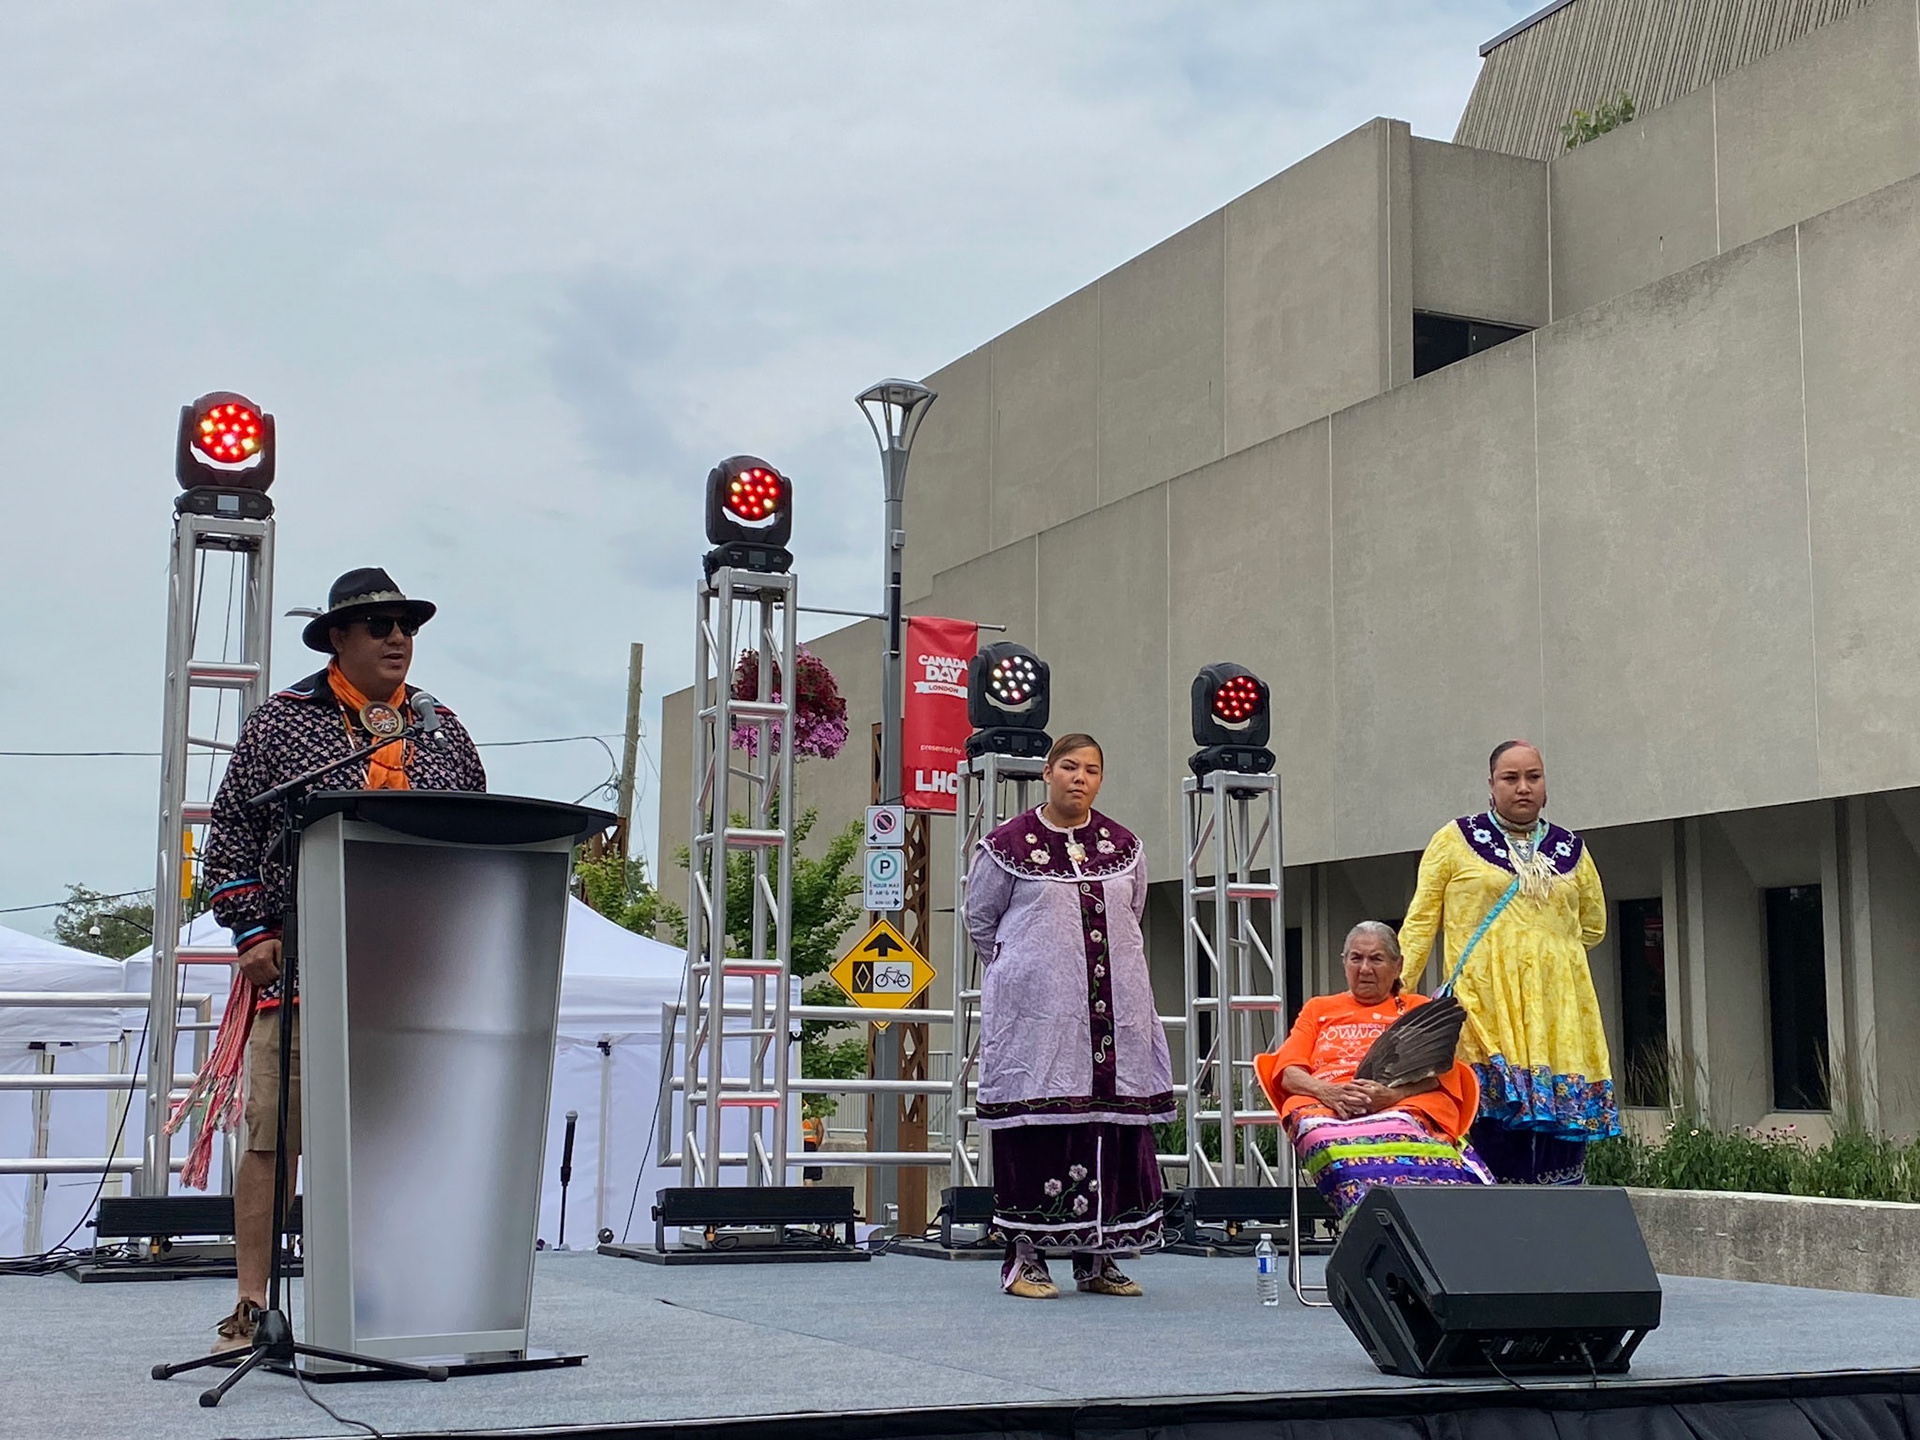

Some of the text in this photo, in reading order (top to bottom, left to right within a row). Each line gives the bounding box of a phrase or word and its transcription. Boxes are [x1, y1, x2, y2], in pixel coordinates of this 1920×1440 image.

[918, 654, 968, 670] CANADA
[926, 665, 962, 684] DAY
[928, 684, 959, 693] LONDON
[920, 744, 961, 755] presented by
[880, 860, 891, 874] P
[1318, 1028, 1383, 1041] OWWO
